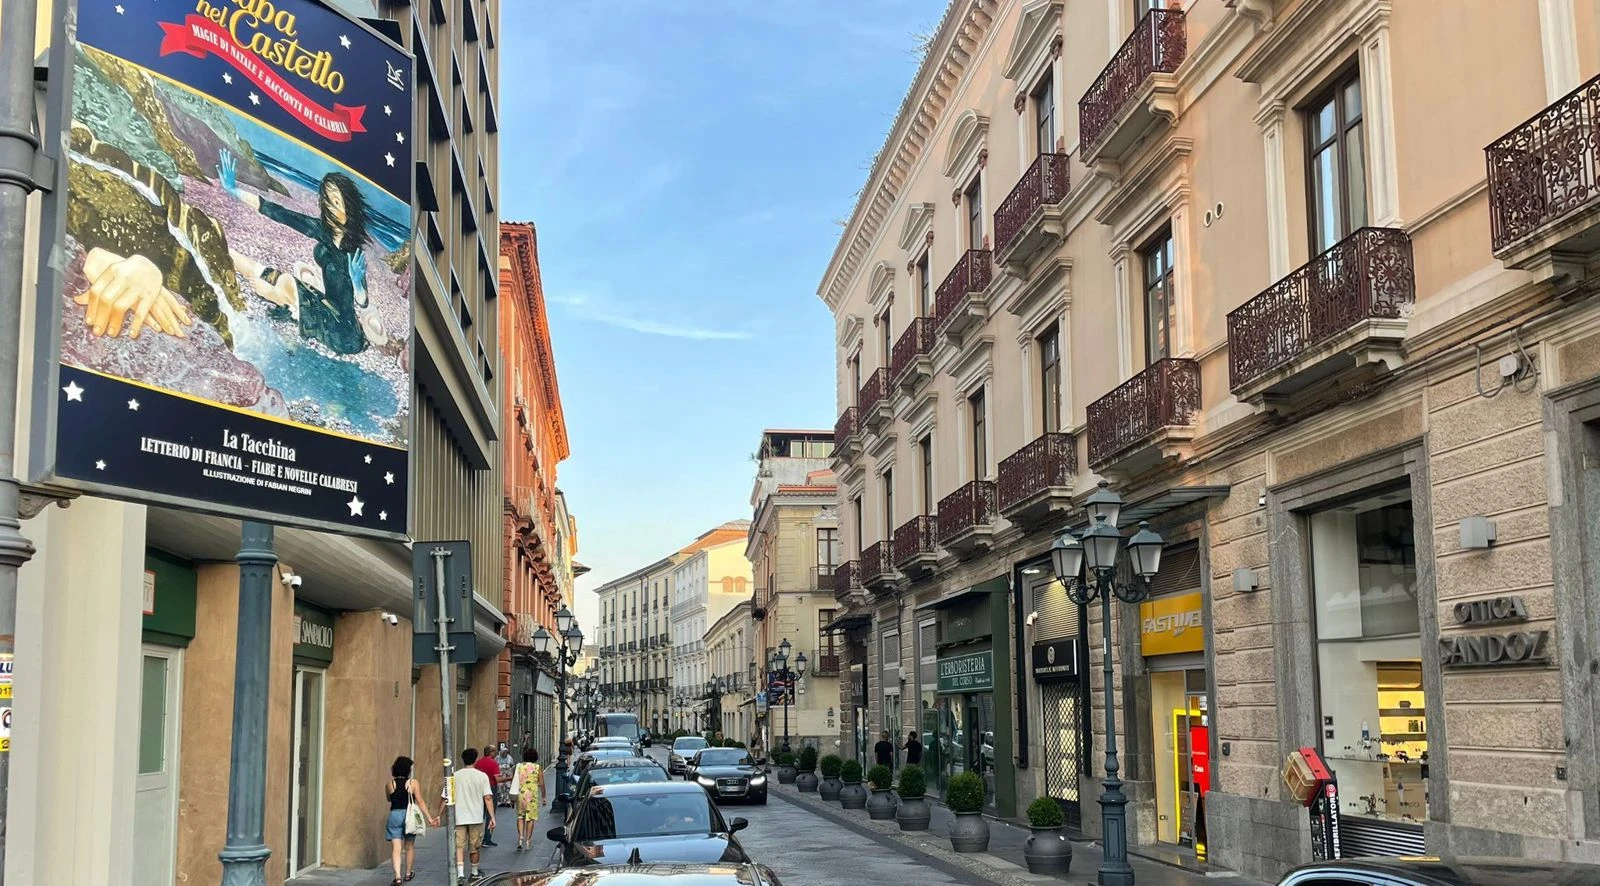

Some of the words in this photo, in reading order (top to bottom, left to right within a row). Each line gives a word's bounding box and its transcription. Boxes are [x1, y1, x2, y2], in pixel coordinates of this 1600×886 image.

[195, 0, 228, 28] nel
[229, 9, 345, 94] Castello
[191, 24, 218, 46] MAGIE
[219, 37, 230, 52] DI
[230, 46, 258, 75] NATALE
[257, 70, 264, 80] E
[264, 75, 303, 113] RACCONTI
[303, 107, 313, 120] DI
[313, 113, 349, 134] CALABRIA
[222, 429, 238, 450] La
[240, 433, 296, 462] Tacchina
[140, 437, 191, 460] LETTERIO
[191, 447, 204, 463] DI
[204, 450, 243, 471] FRANCIA
[251, 459, 277, 477] FIABE
[277, 465, 284, 479] E
[284, 466, 319, 486] NOVELLE
[319, 474, 359, 494] CALABRESI
[202, 468, 256, 486] ILLUSTRAZIONE
[256, 479, 264, 487] DI
[264, 480, 288, 491] FABIAN
[288, 485, 312, 496] NEGRIN
[1454, 595, 1528, 623] OTTICA
[1439, 631, 1550, 665] SANDOZ
[940, 657, 986, 676] L'ERBORISTERIA
